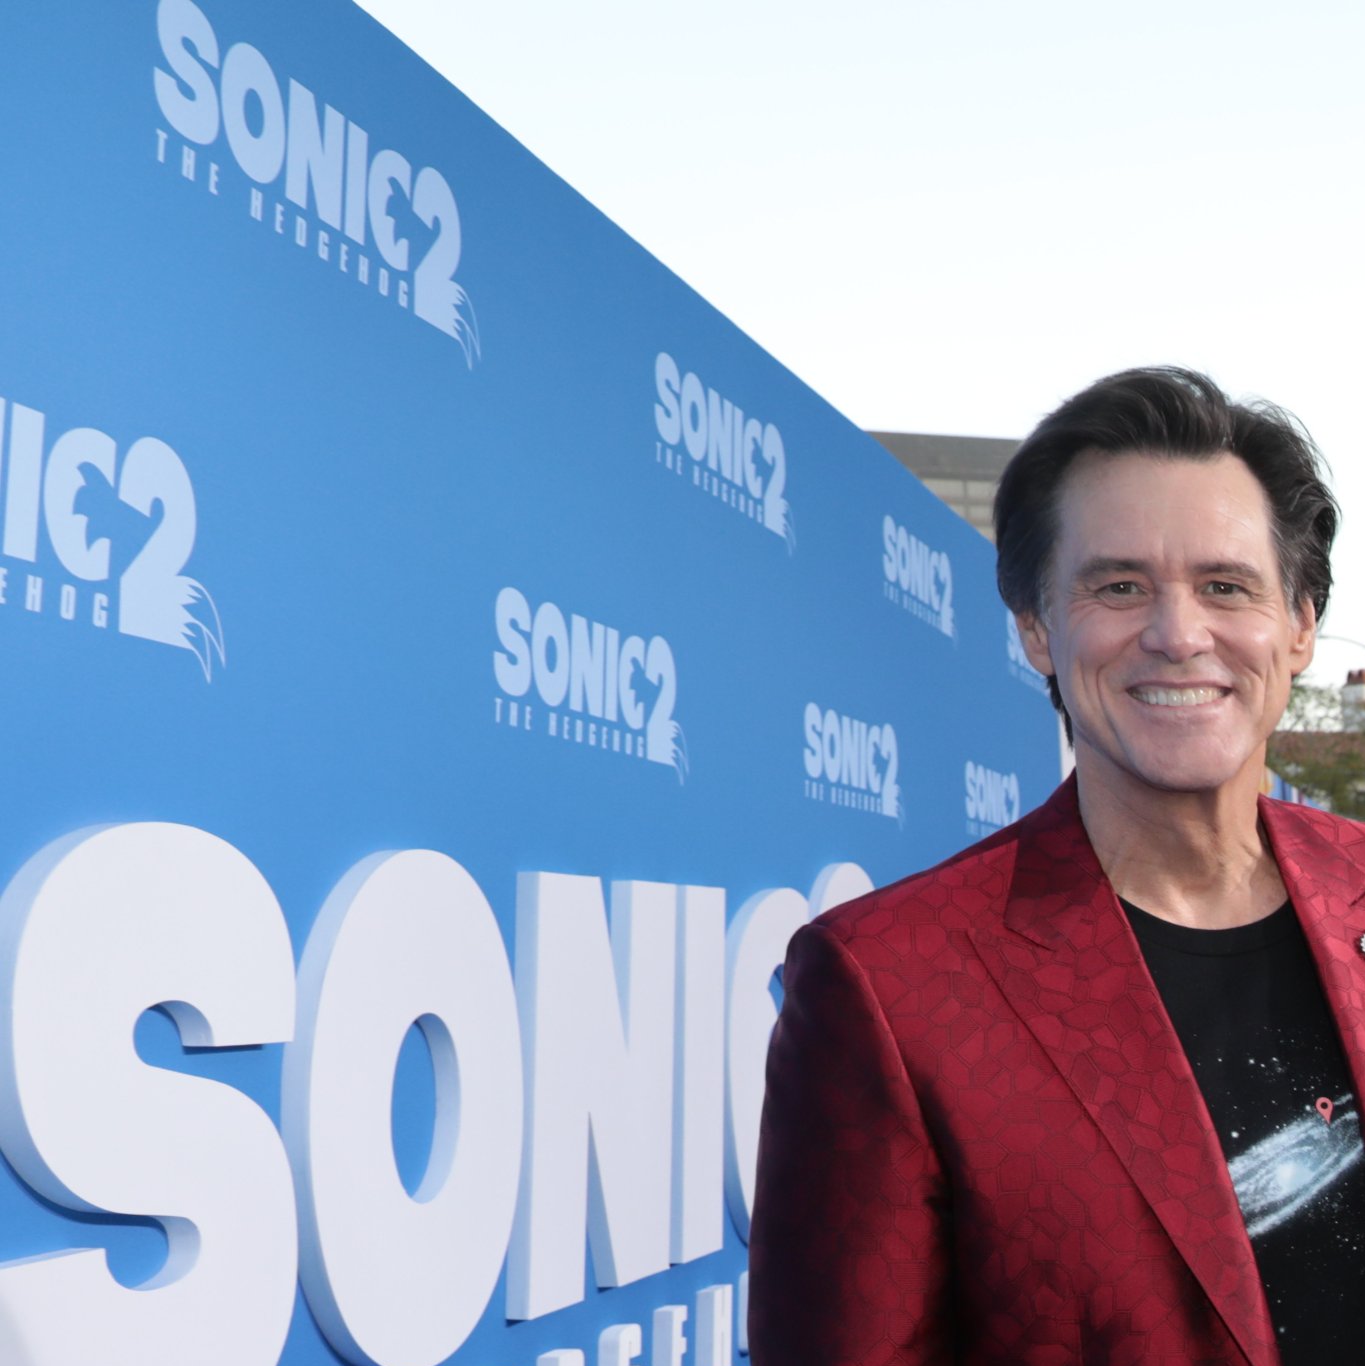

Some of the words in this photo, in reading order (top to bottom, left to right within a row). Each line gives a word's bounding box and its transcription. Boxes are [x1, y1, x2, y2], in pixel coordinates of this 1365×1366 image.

[155, 128, 220, 195] THE
[250, 188, 409, 310] HEDGEHOG
[495, 697, 532, 732] THE
[548, 705, 645, 760] HEDGEHOG
